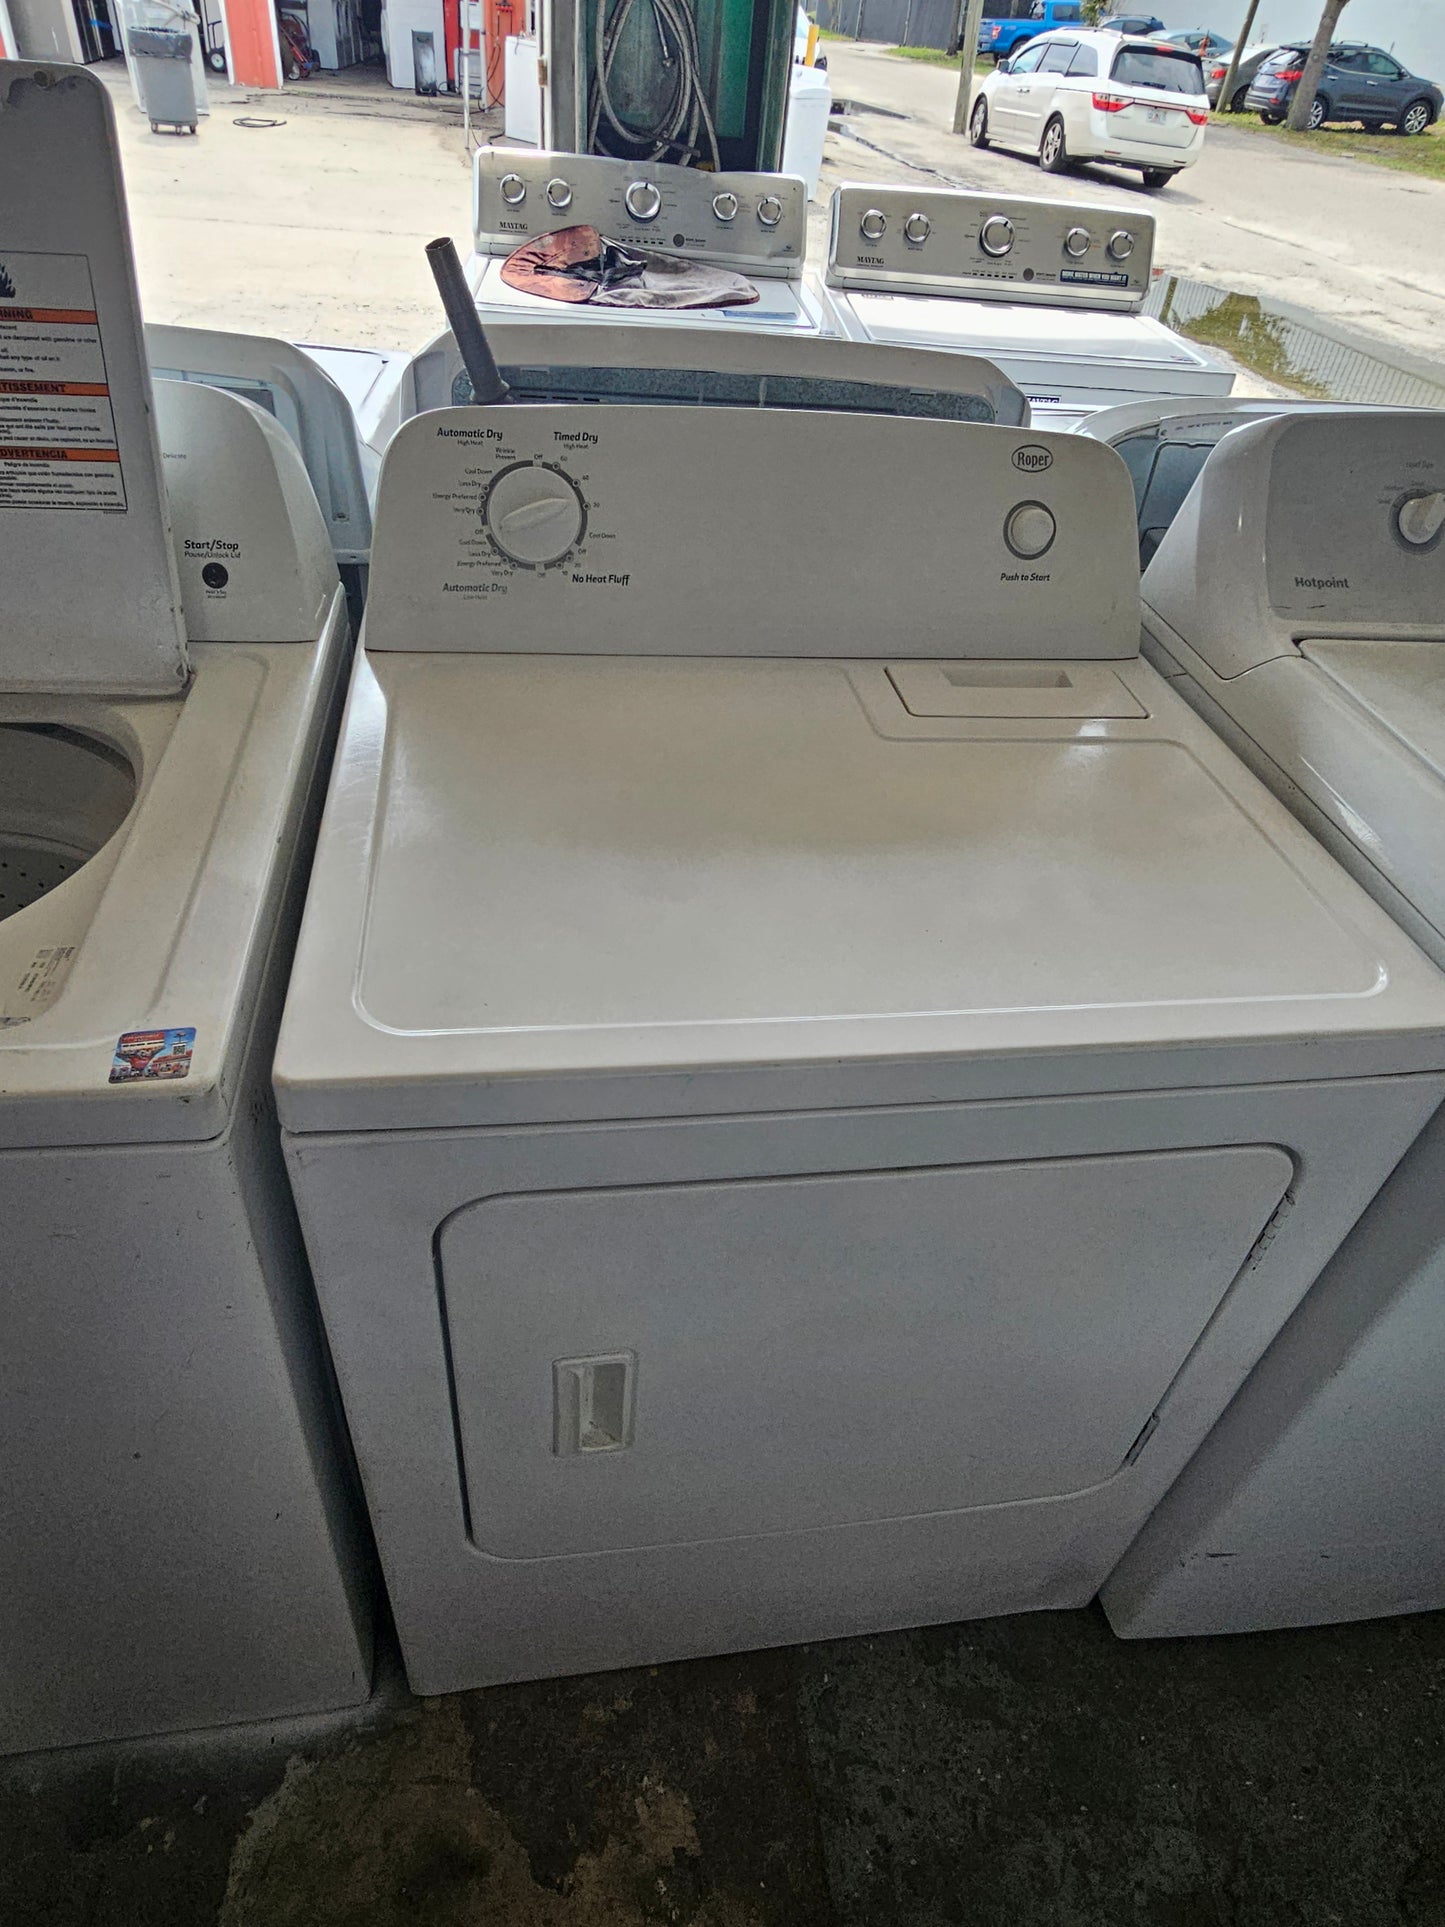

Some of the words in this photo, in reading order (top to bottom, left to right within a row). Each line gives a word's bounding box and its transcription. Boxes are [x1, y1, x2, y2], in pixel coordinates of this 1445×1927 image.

[499, 222, 528, 230] MAYTAG
[856, 256, 884, 264] MAYTAG
[437, 427, 484, 438] Automatic
[487, 430, 503, 441] Dry
[554, 432, 580, 441] Timed
[582, 433, 598, 444] Dry
[1017, 452, 1050, 468] Roper
[472, 480, 482, 489] Dry
[184, 540, 239, 552] Start/Stop
[572, 574, 584, 583] No
[586, 574, 606, 584] Heat
[608, 574, 631, 586] Fluff
[1000, 573, 1019, 581] Push
[1030, 573, 1050, 582] Start
[1294, 577, 1349, 590] Hotpoint
[443, 582, 490, 592] Automatic
[491, 583, 508, 594] Dry
